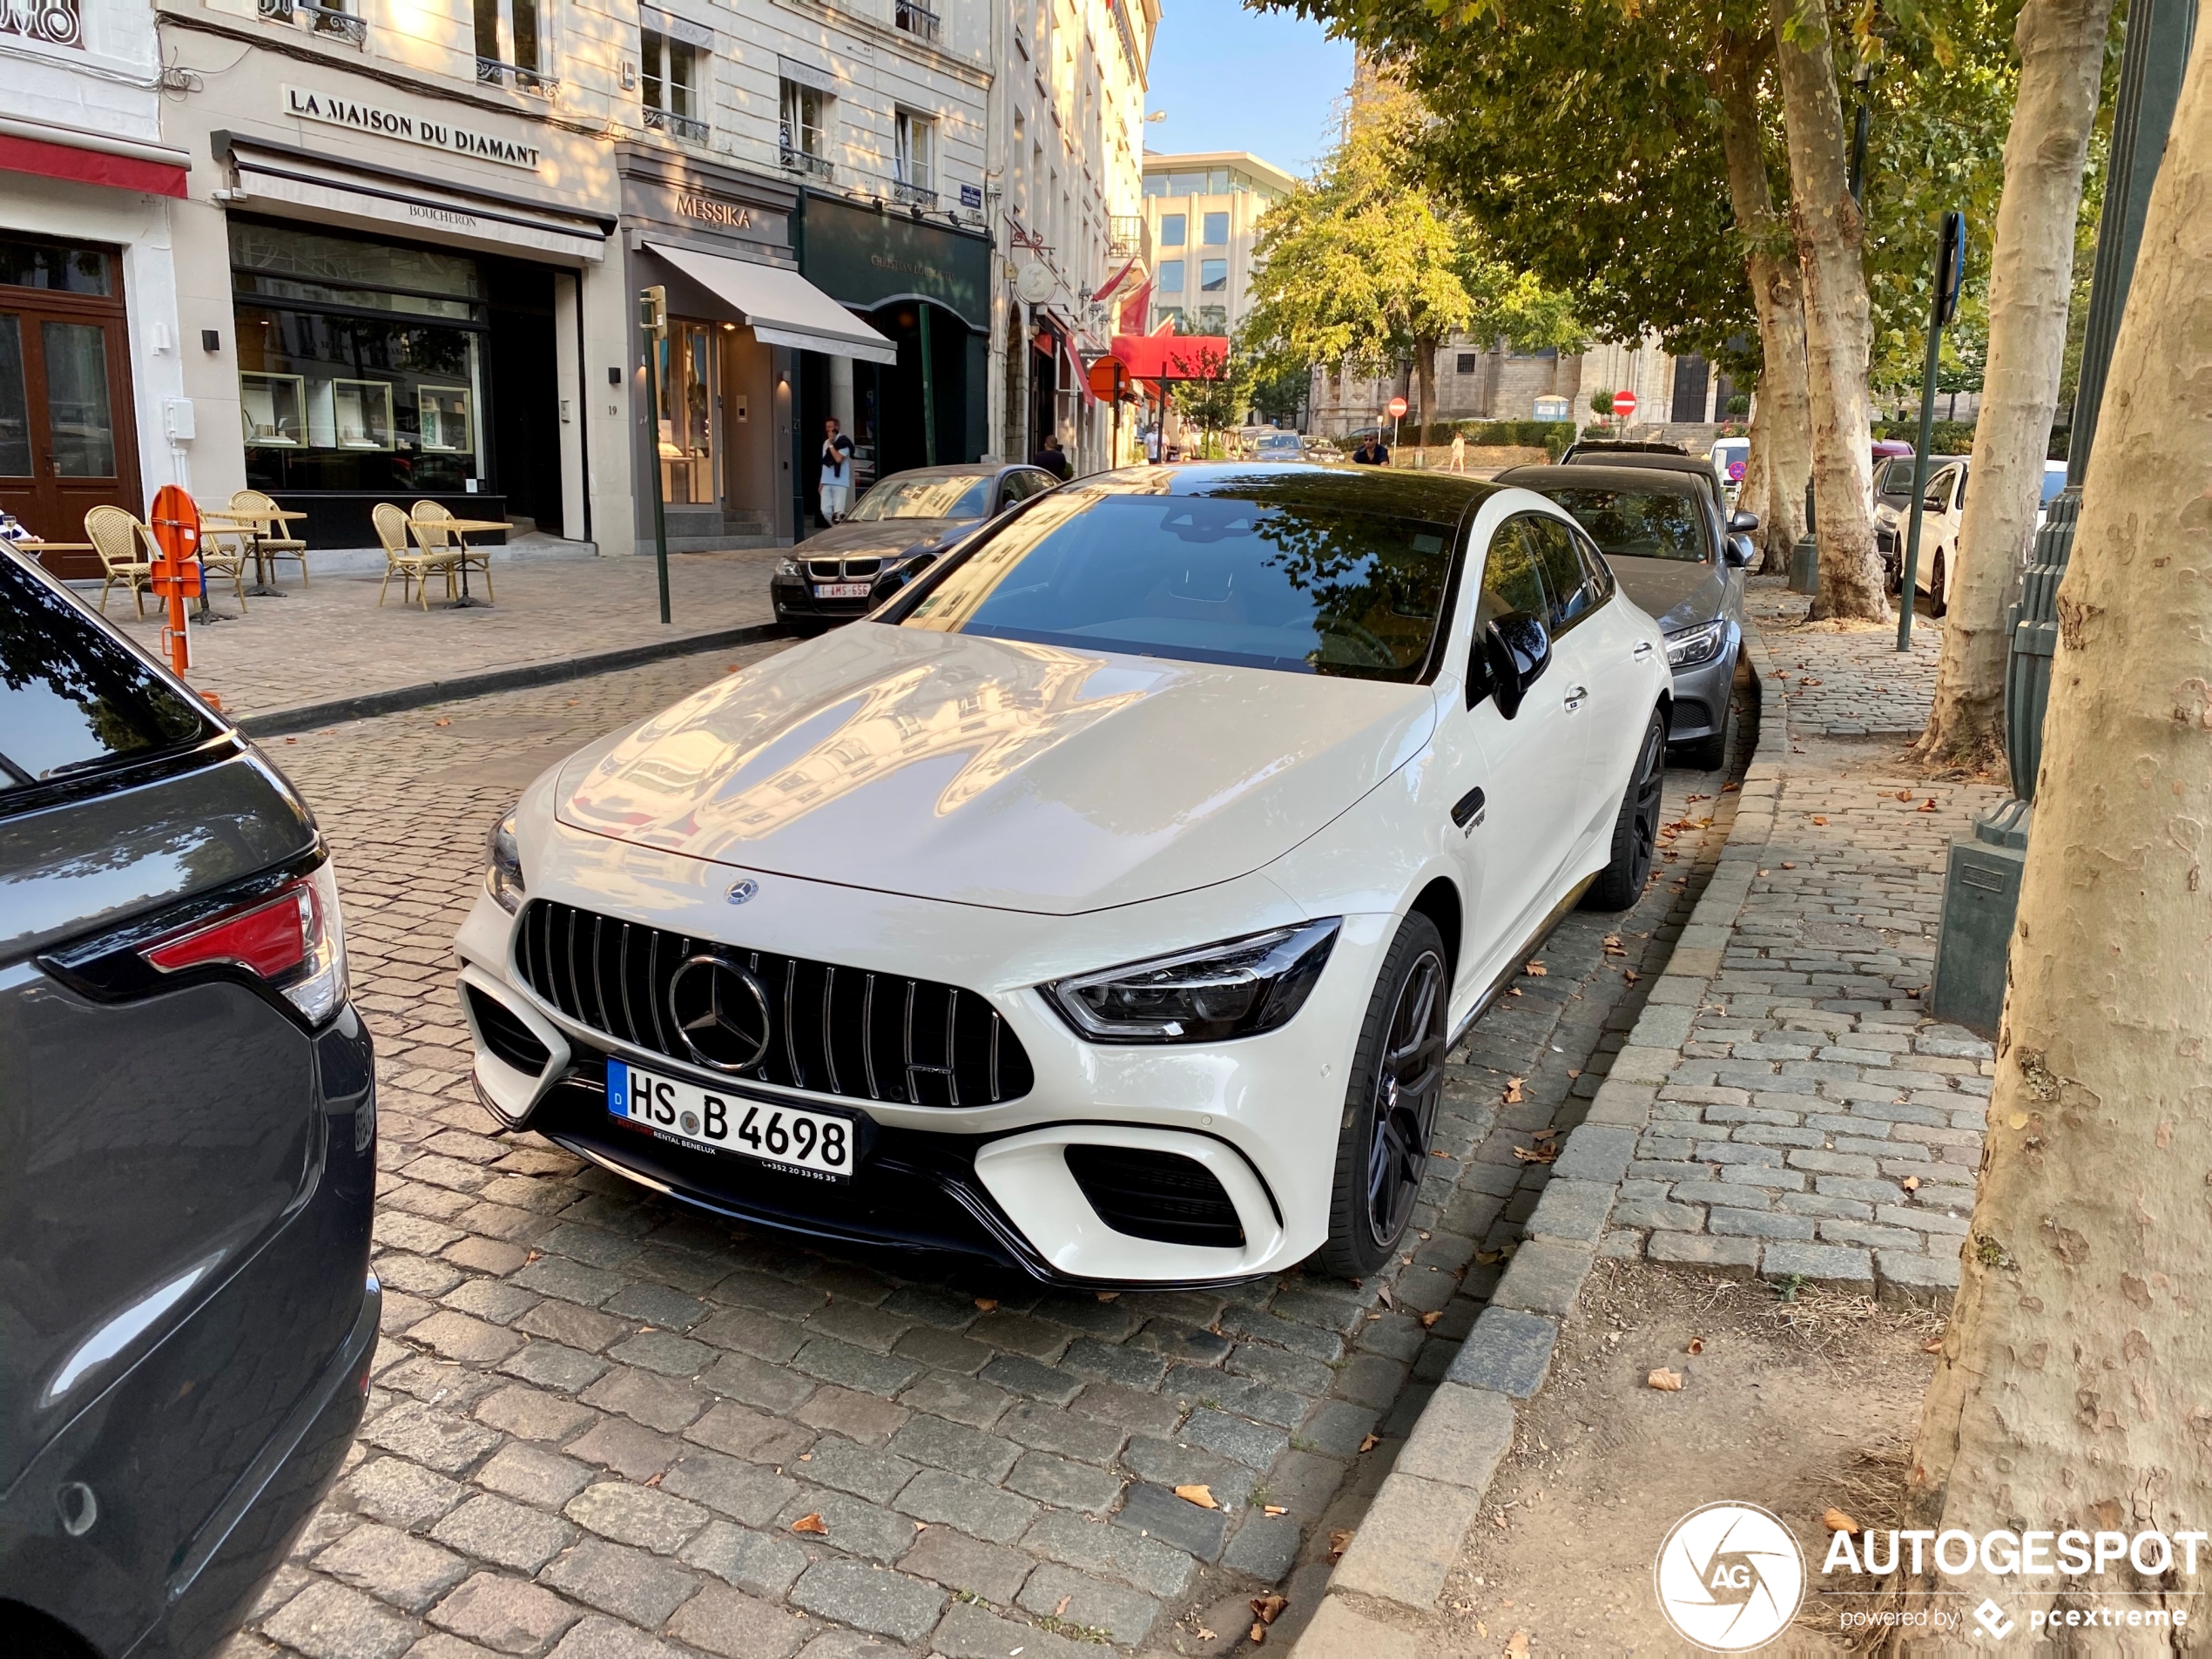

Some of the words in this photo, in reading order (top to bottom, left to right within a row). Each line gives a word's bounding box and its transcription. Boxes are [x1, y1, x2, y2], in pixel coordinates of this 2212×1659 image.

[793, 65, 826, 84] MESSIKA
[290, 90, 320, 115] LA
[327, 98, 413, 137] MAISON
[420, 122, 448, 144] DU
[455, 131, 540, 166] DIAMANT
[409, 205, 476, 227] BOUCHERON
[674, 192, 752, 229] MESSIKA
[871, 254, 912, 273] CHRISTIAN
[914, 265, 956, 281] LOUBOUTIN
[609, 405, 617, 415] 19
[615, 1092, 622, 1105] D
[617, 1117, 634, 1128] BEST
[631, 1072, 677, 1125] HS
[704, 1095, 728, 1140] B
[738, 1106, 846, 1166] 4698
[653, 1130, 680, 1145] RENTAL
[681, 1140, 716, 1155] BENELUX
[767, 1163, 786, 1172] +352
